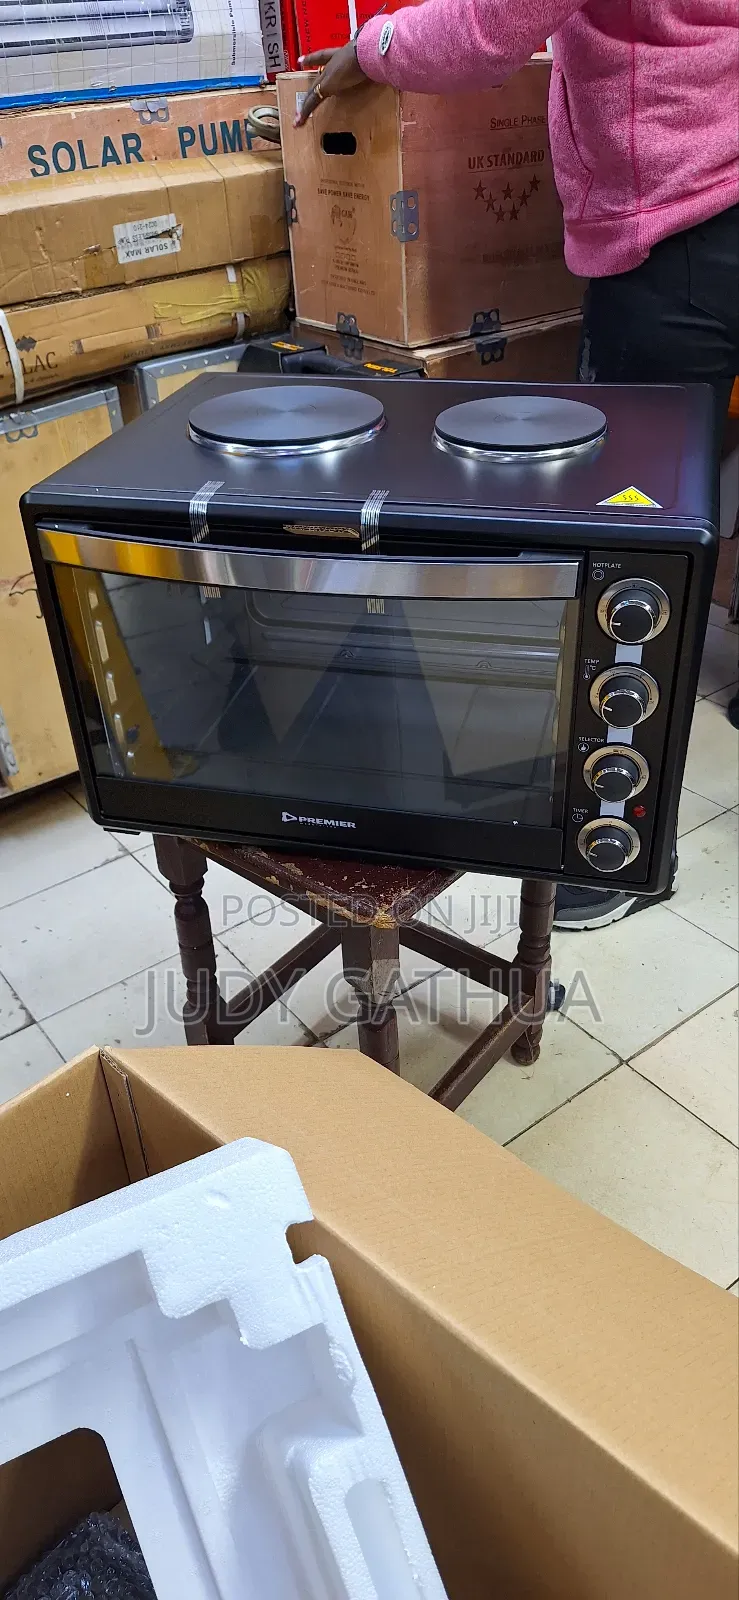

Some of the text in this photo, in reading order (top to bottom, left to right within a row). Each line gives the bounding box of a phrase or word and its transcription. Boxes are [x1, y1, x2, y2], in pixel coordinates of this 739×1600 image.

[490, 117, 518, 129] SINGLE
[28, 132, 145, 178] SOLAR
[468, 150, 545, 169] UK STANDARD
[354, 193, 370, 201] ENERGY
[124, 242, 169, 258] SOLAR MAX
[298, 816, 356, 829] PREMIER
